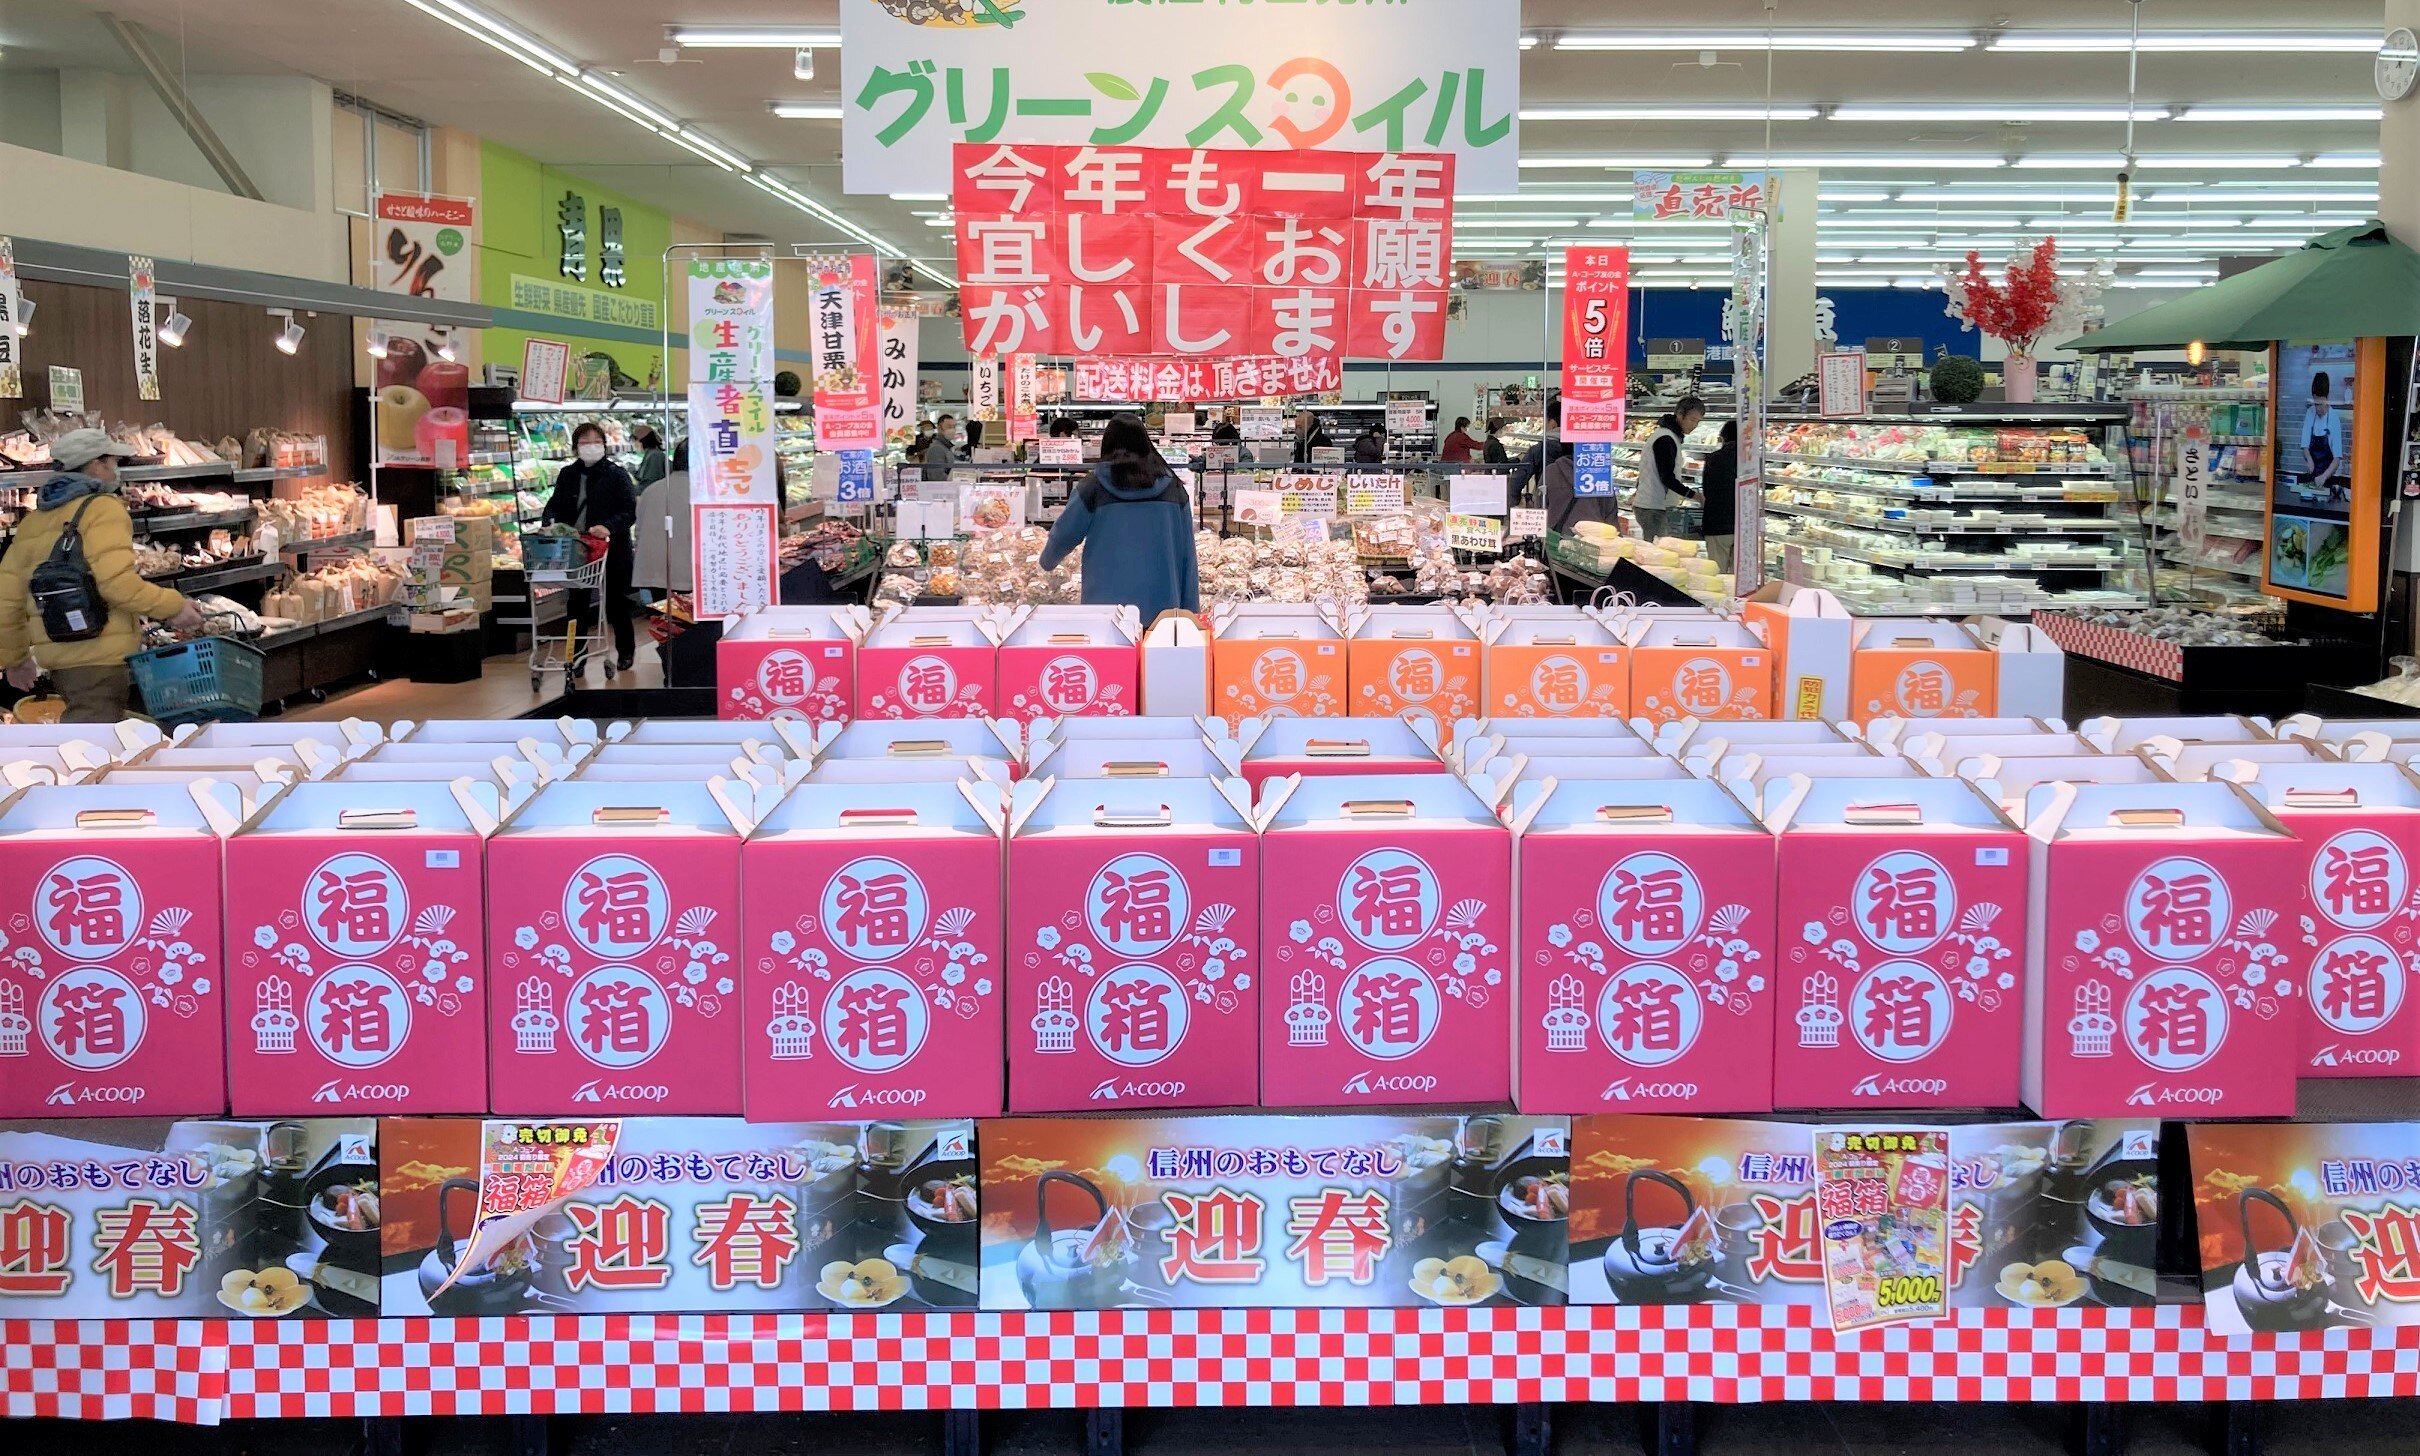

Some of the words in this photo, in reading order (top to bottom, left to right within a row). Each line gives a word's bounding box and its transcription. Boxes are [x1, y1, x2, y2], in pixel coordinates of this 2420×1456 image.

[964, 145, 1444, 220] 今年も一年
[1654, 185, 1763, 218] 直売所
[966, 212, 1444, 290] 宜しくお願
[1585, 255, 1608, 266] 本日
[1576, 281, 1619, 292] ポイント
[138, 300, 151, 374] 落花生
[820, 290, 845, 370] 天津甘栗
[969, 284, 1439, 360] がいします
[883, 338, 906, 419] みかん
[979, 366, 992, 407] いちご
[708, 321, 752, 495] 生産者直売
[1275, 477, 1334, 491] しめじ
[1350, 477, 1401, 489] しいたけ
[1580, 473, 1609, 493] 3倍
[765, 658, 805, 697] 福
[907, 665, 945, 704] 福
[1047, 665, 1087, 704] 福
[1259, 657, 1297, 696] 福
[1396, 657, 1435, 696] 福
[1540, 664, 1579, 704] 福
[1682, 666, 1722, 706] 福
[1906, 669, 1945, 710] 福
[517, 1126, 589, 1145] 売切御免
[1147, 1148, 1402, 1179] 信州のおもてなし
[484, 1174, 554, 1213] 福箱
[1822, 1179, 1889, 1219] 福箱
[562, 1193, 800, 1290] 迎春
[1160, 1186, 1391, 1286] 迎春
[2341, 1202, 2420, 1306] 迎
[1879, 1276, 1941, 1306] 5,000円
